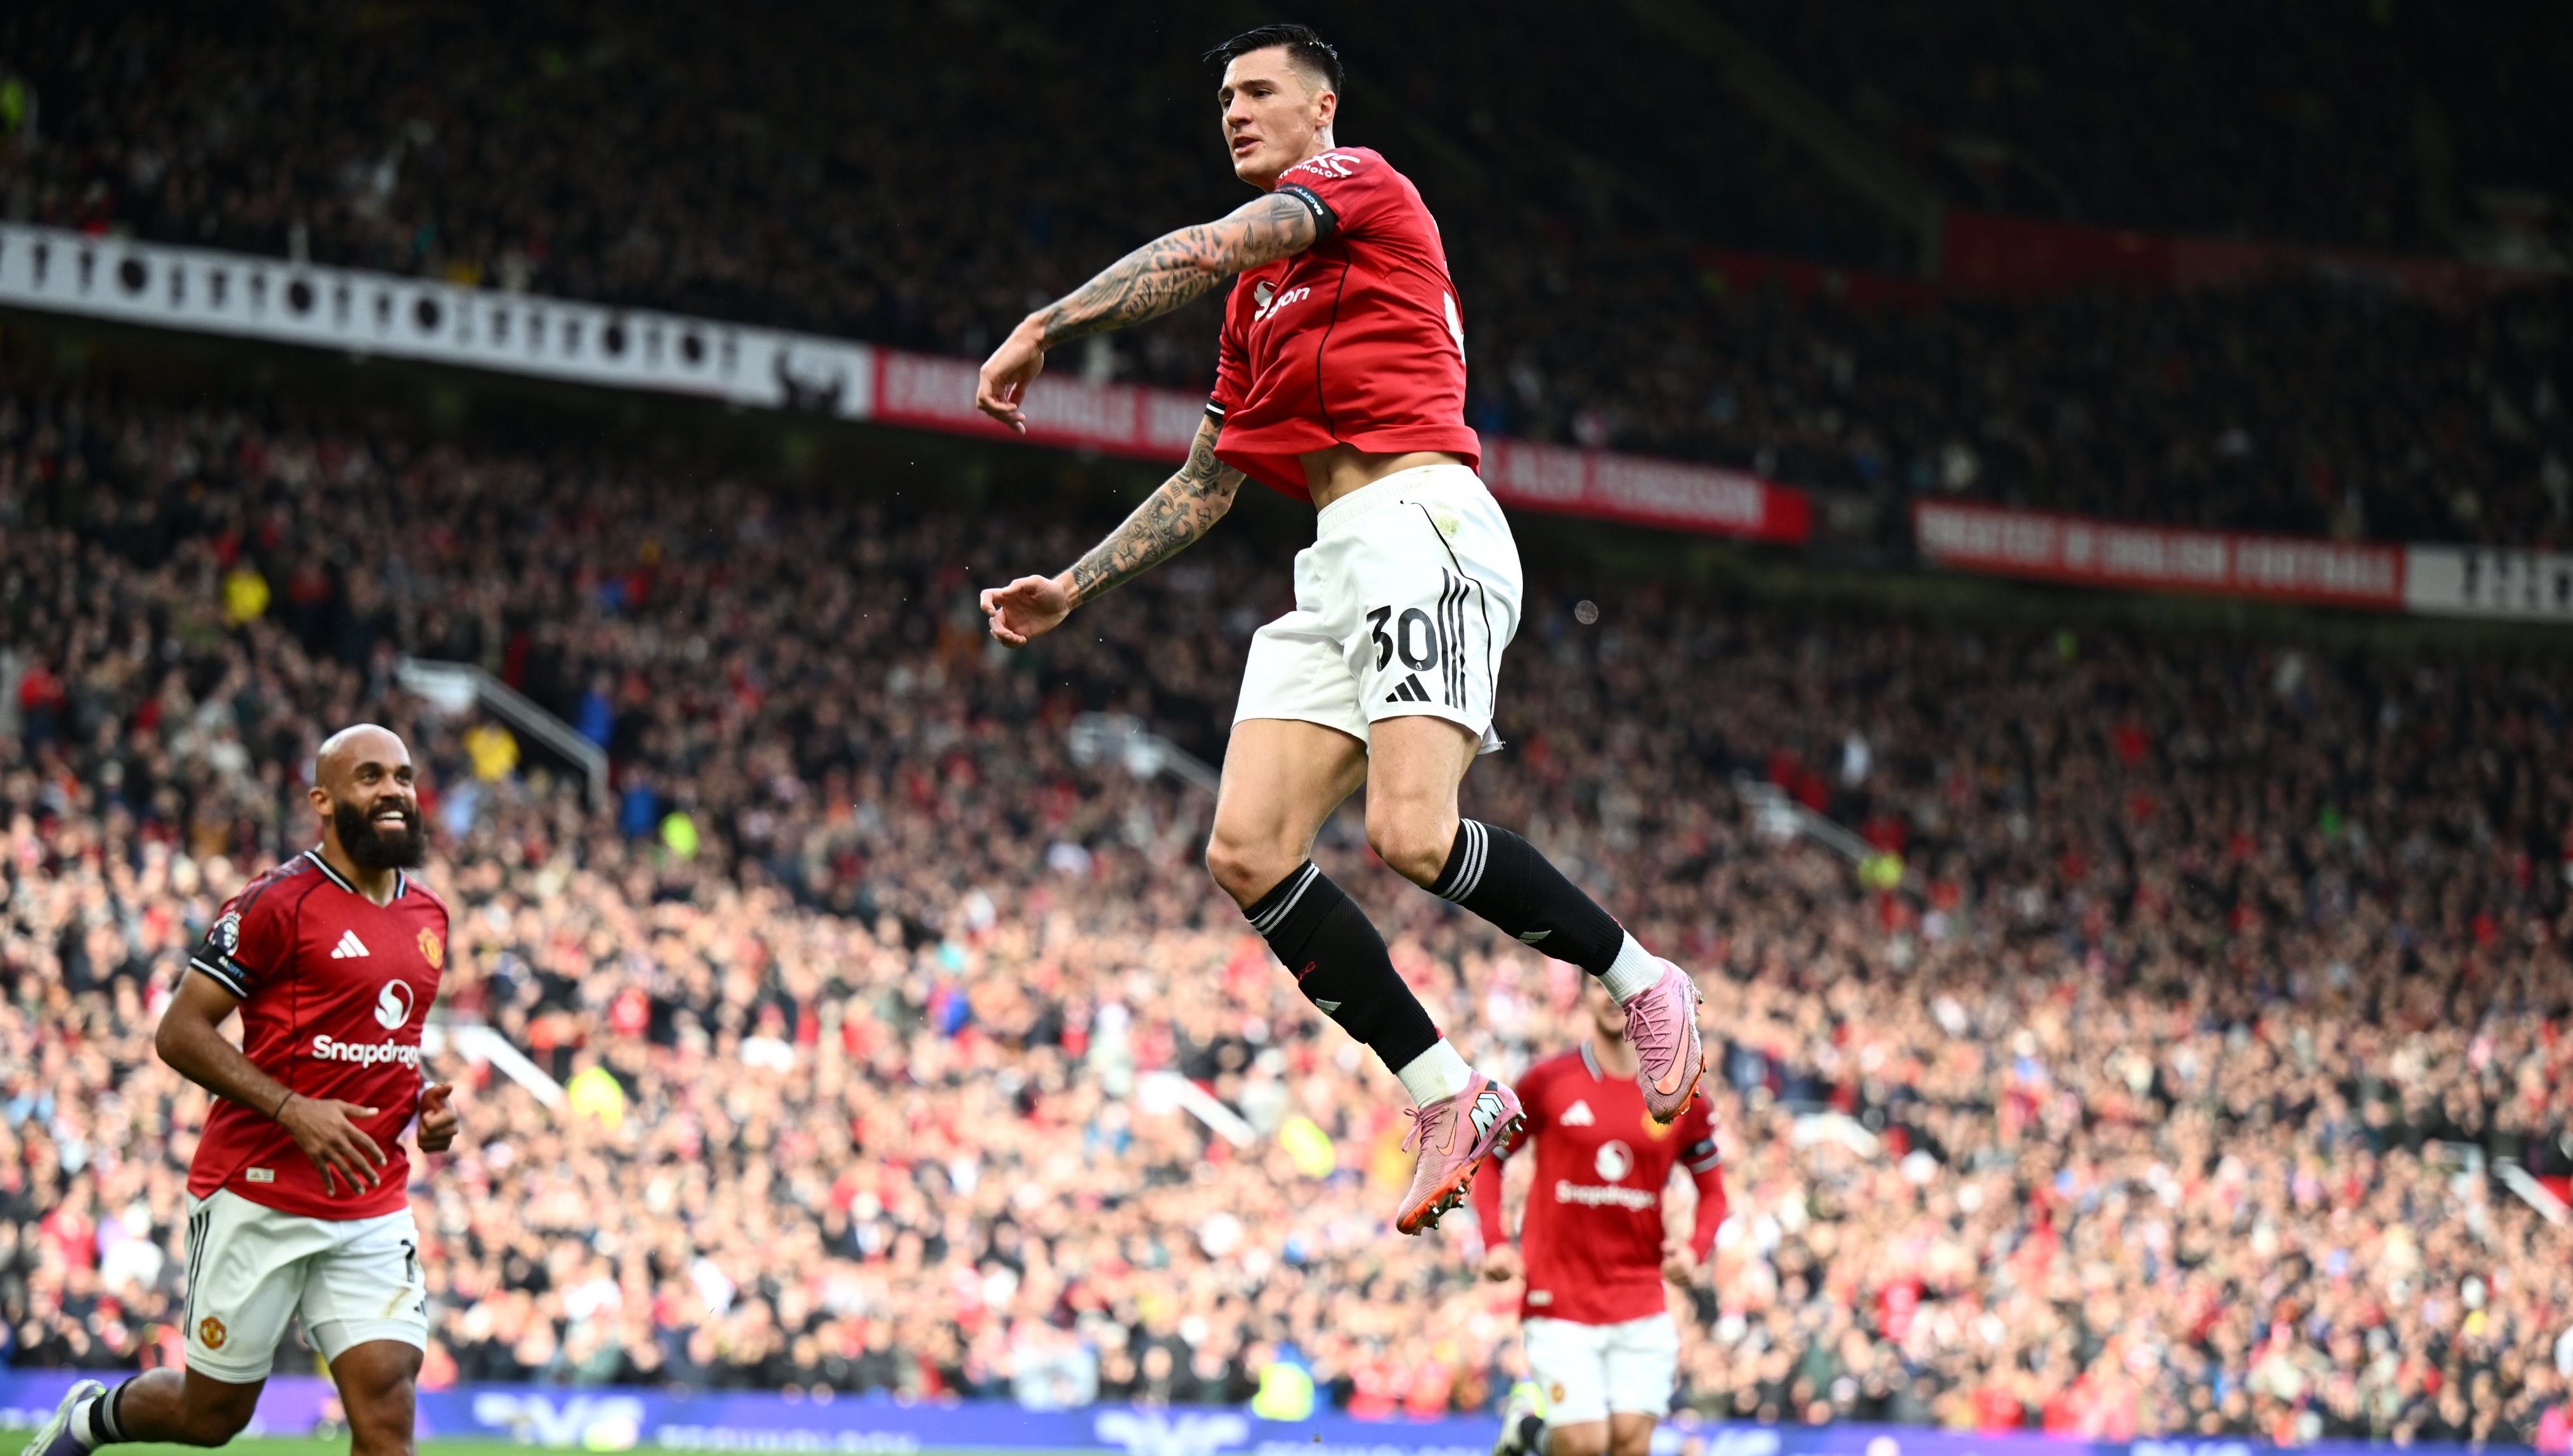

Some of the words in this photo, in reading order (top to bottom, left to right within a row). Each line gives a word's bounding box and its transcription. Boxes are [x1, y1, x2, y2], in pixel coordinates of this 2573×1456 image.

[1278, 164, 1347, 178] TECHNOLO
[1366, 605, 1438, 672] 30
[312, 1034, 421, 1069] Snapdrag
